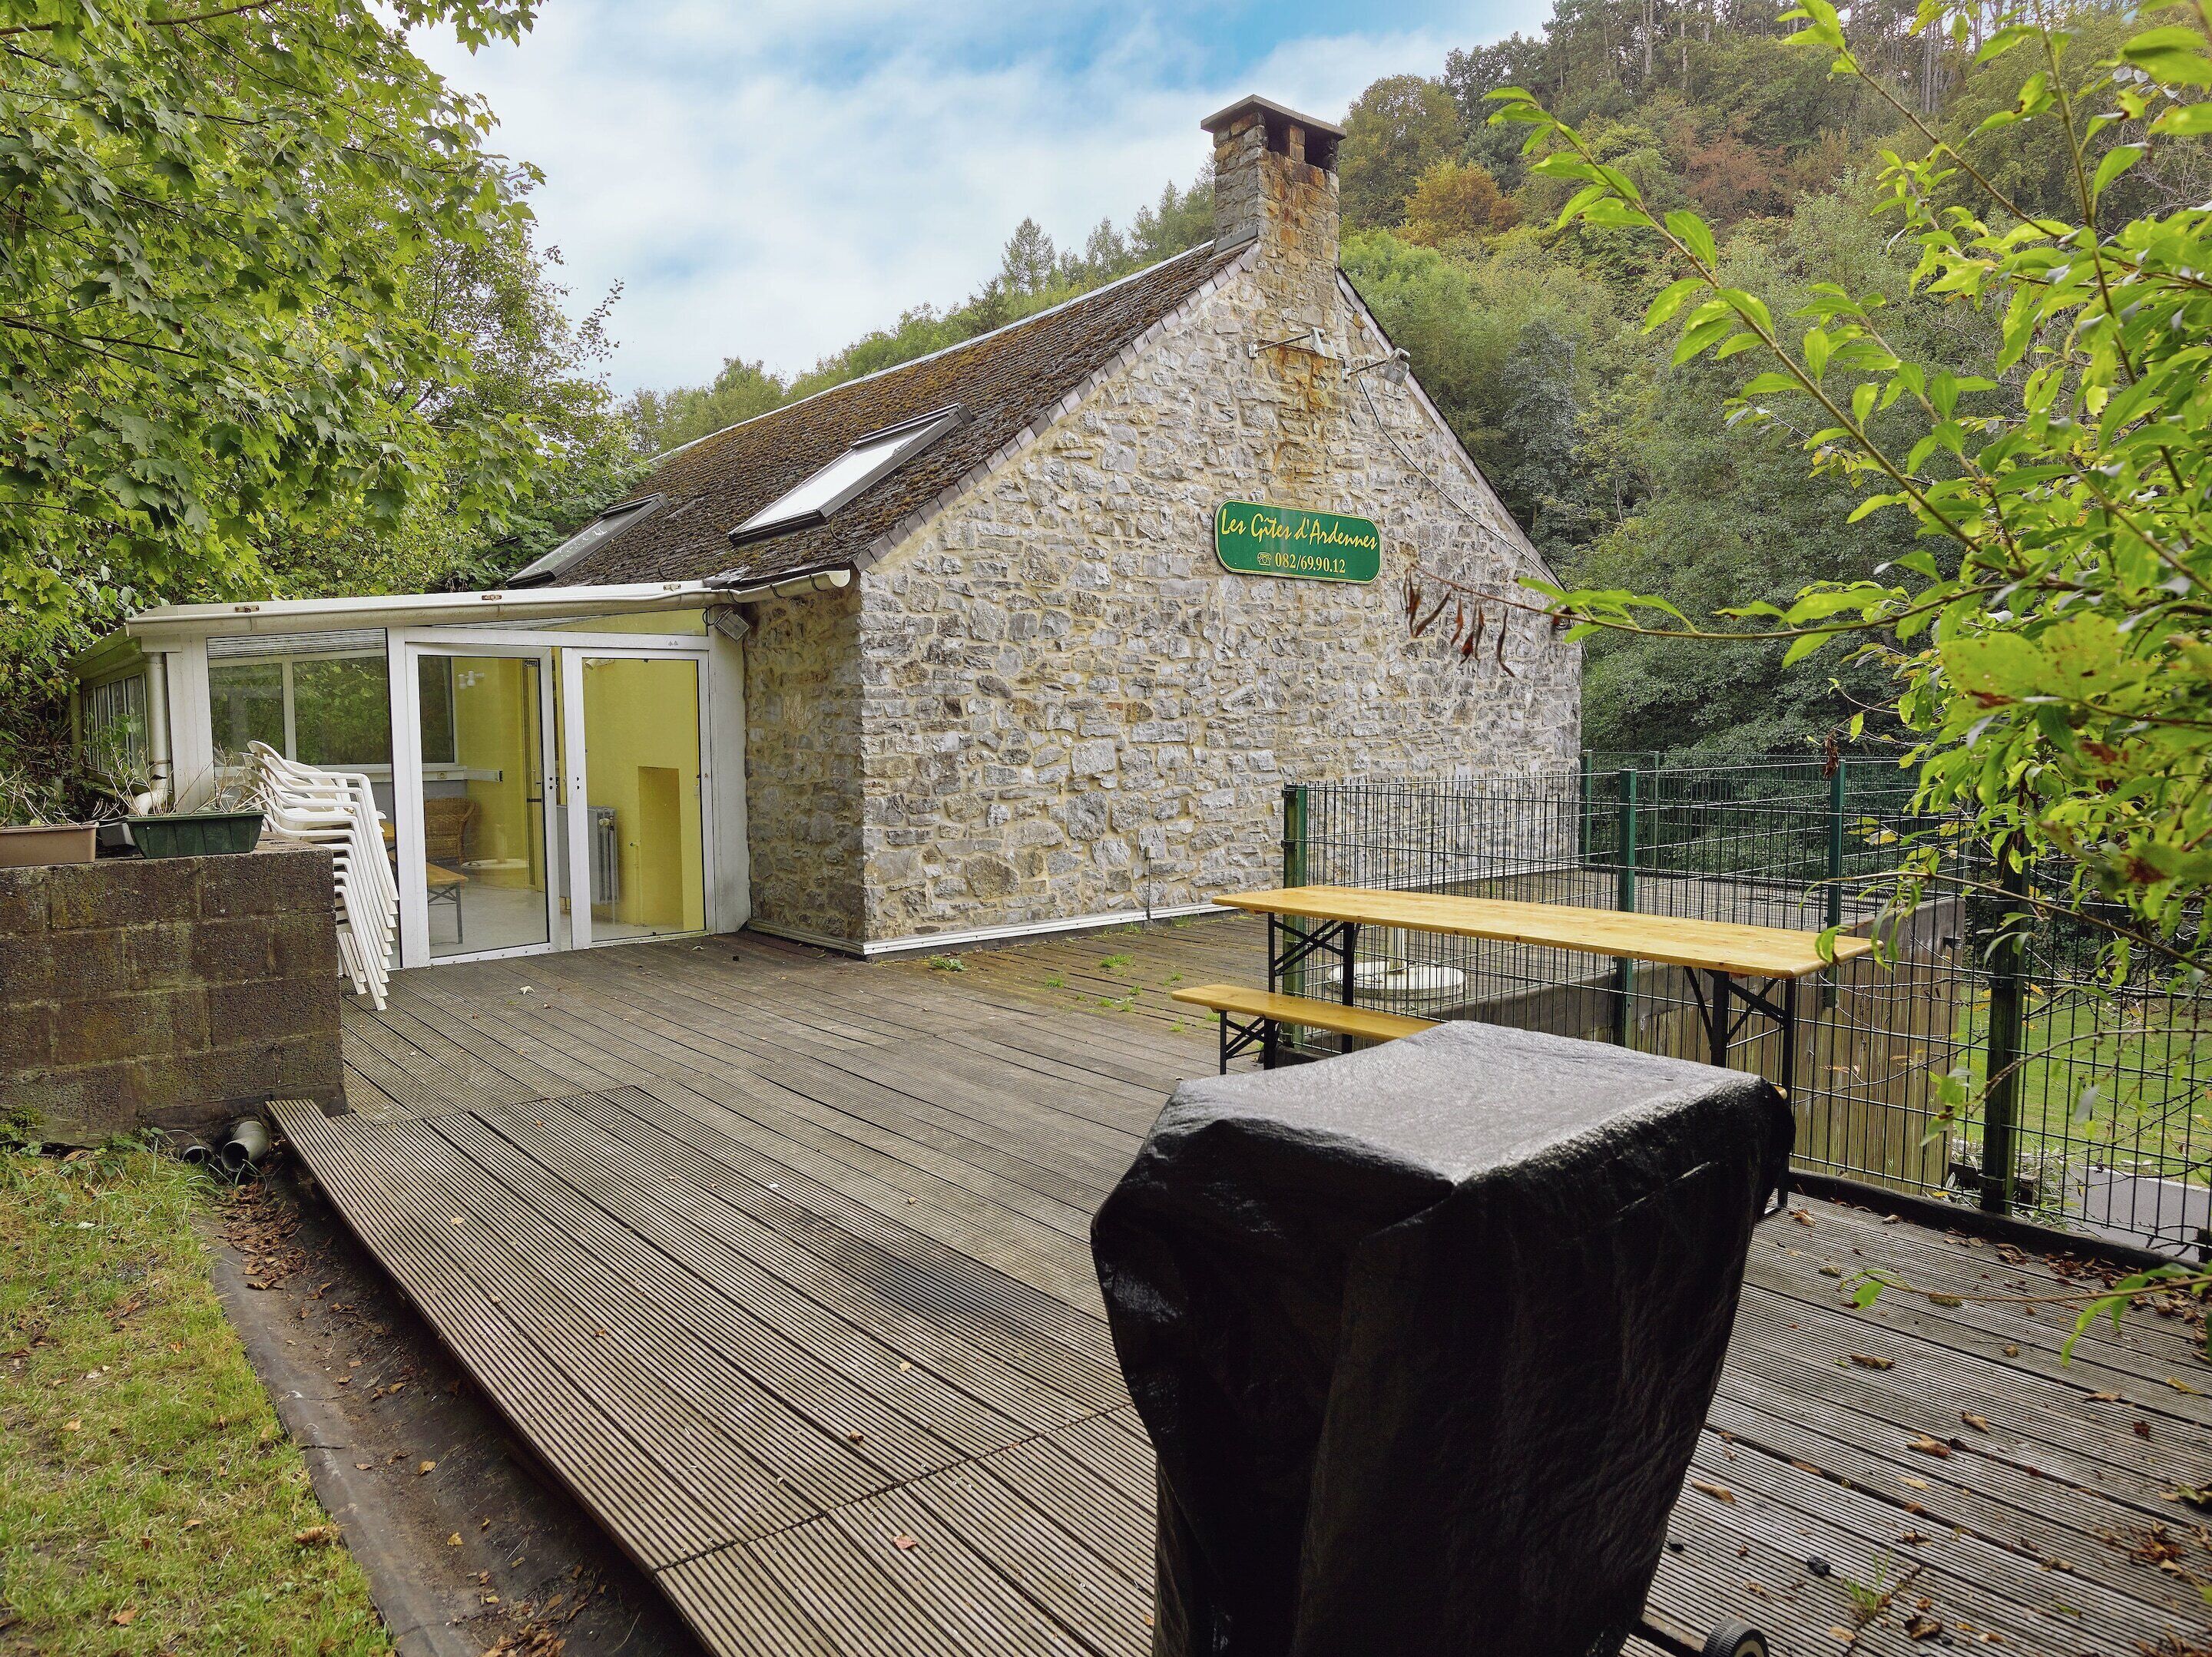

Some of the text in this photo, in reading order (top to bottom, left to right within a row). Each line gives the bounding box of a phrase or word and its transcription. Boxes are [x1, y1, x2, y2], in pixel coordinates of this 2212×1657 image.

[1221, 508, 1246, 535] Les
[1294, 518, 1377, 550] d'Ardennes
[1275, 552, 1346, 574] 082/69.90.12
